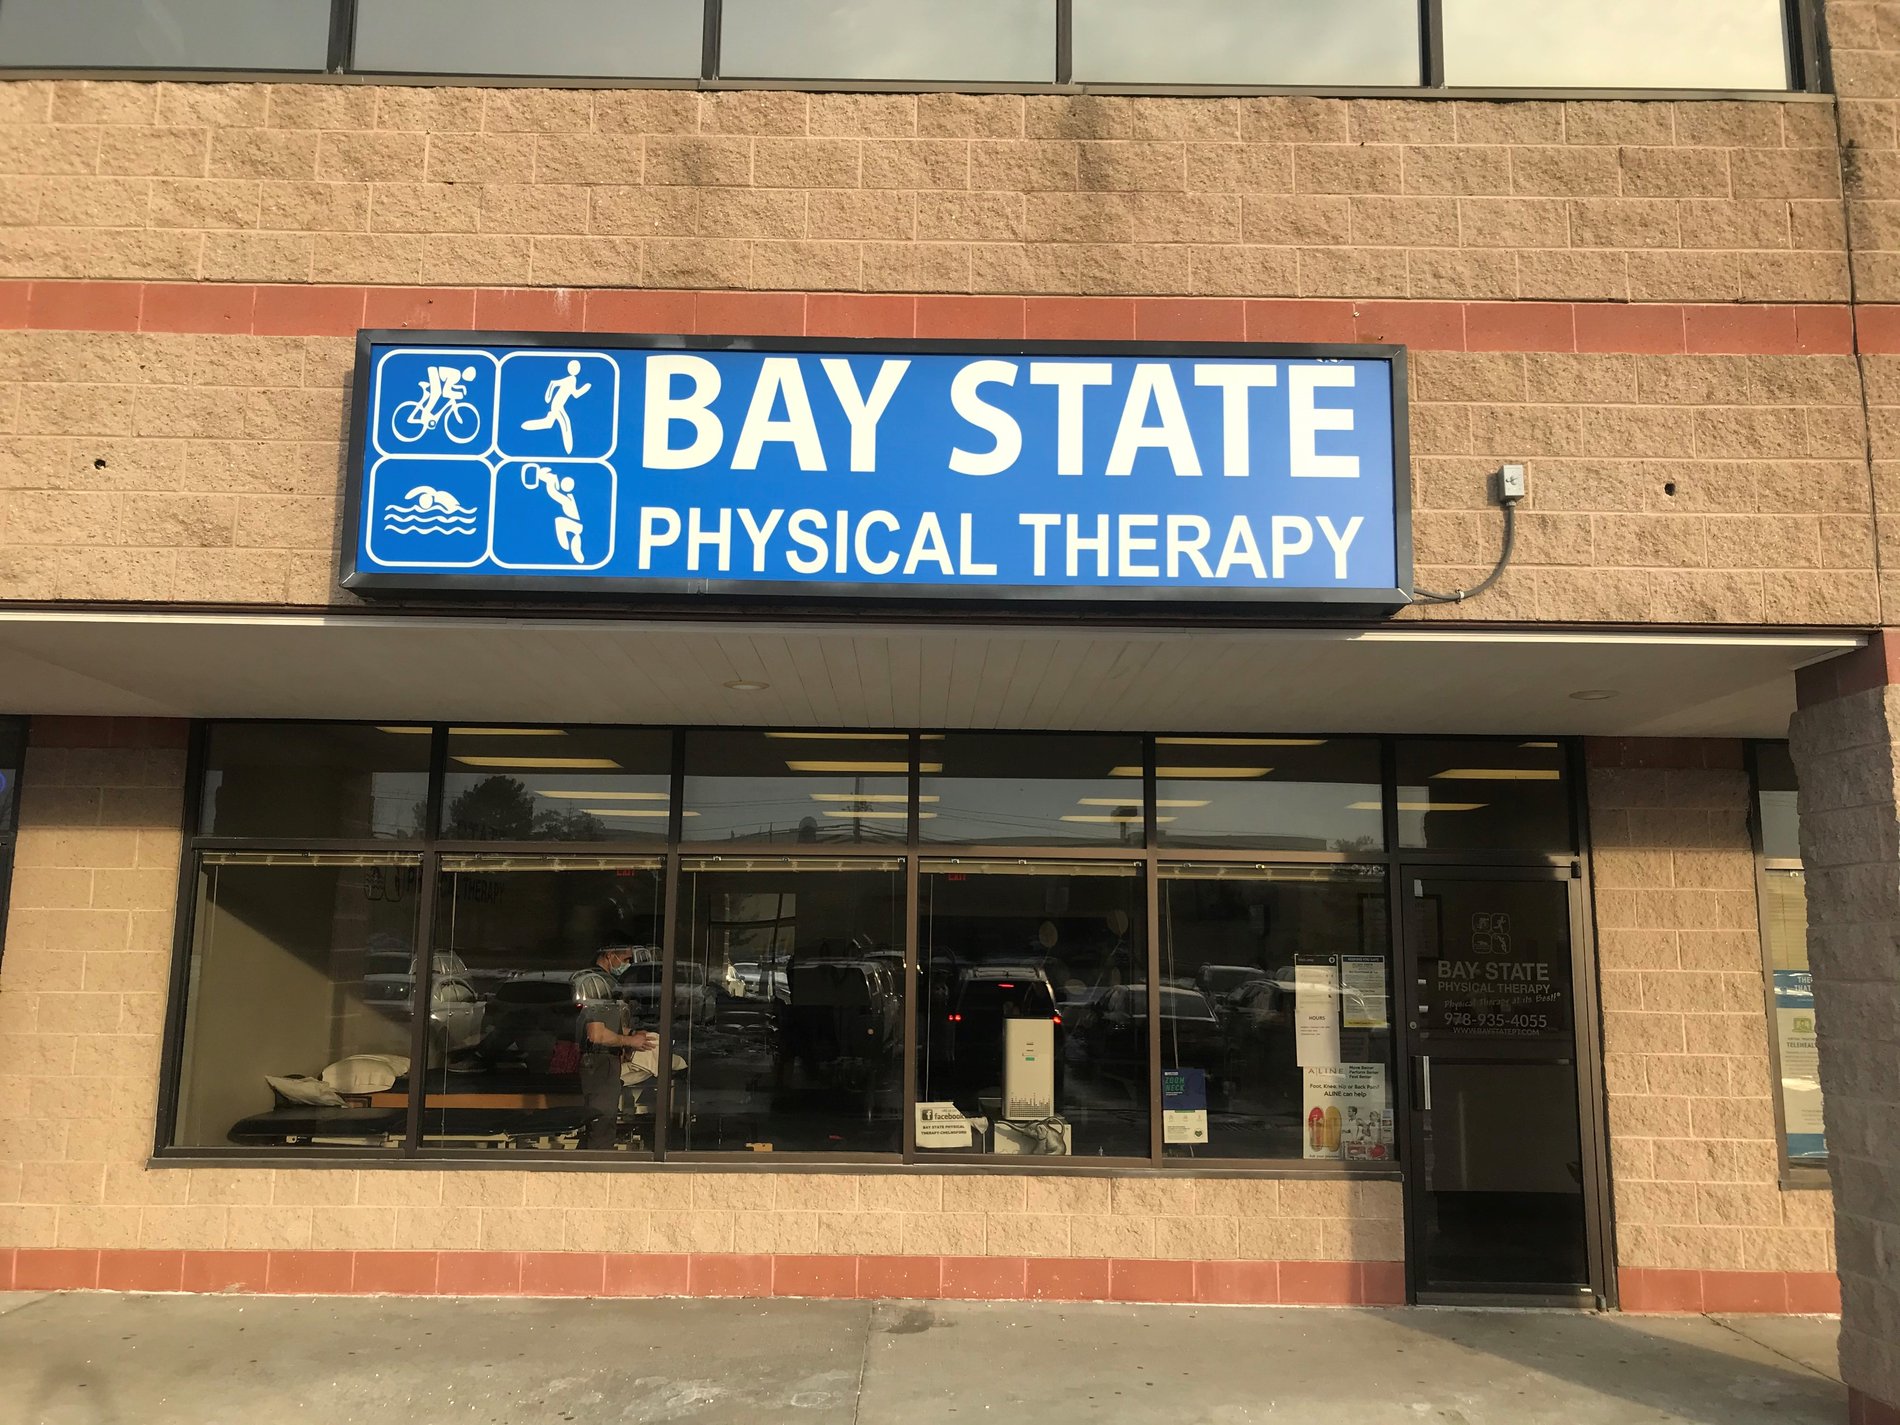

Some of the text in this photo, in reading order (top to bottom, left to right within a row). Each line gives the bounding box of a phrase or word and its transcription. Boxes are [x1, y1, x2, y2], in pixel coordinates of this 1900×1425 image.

[642, 355, 1360, 478] BAY STATE
[638, 506, 1364, 580] PHYSICAL THERAPY
[1438, 960, 1549, 980] BAY STATE
[1438, 981, 1551, 993] PHYSICAL THERAPY
[1444, 1012, 1547, 1028] 978-935-4055
[1165, 1077, 1185, 1085] ZOOM
